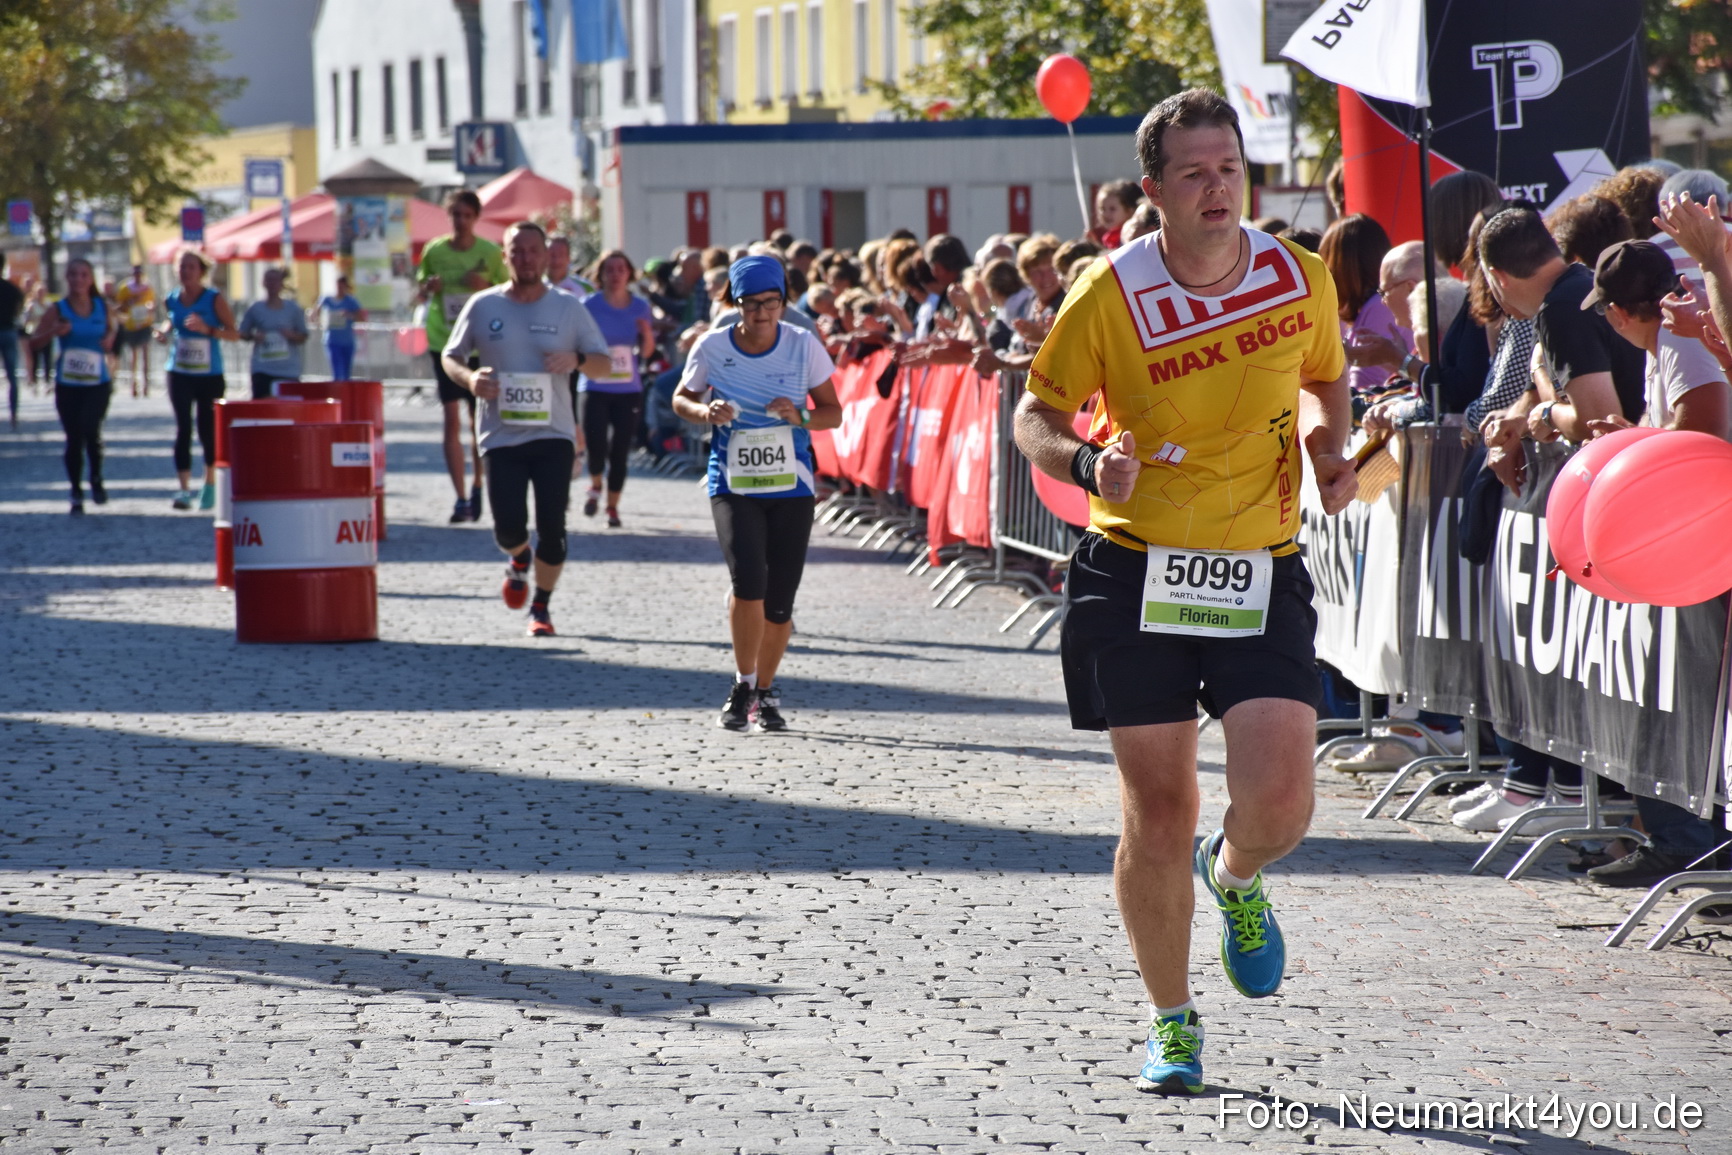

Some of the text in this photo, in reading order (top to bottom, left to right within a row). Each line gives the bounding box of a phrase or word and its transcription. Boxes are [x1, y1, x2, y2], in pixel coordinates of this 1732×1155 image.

[1478, 51, 1503, 62] Team
[1147, 310, 1313, 386] MAX BÖGL
[1030, 367, 1067, 398] oegl.de
[505, 387, 544, 404] 5033
[737, 445, 787, 467] 5064
[752, 477, 775, 487] Petra
[1164, 554, 1254, 593] 5099
[1169, 591, 1234, 604] PARTL Neumarkt
[1179, 607, 1230, 626] Florian
